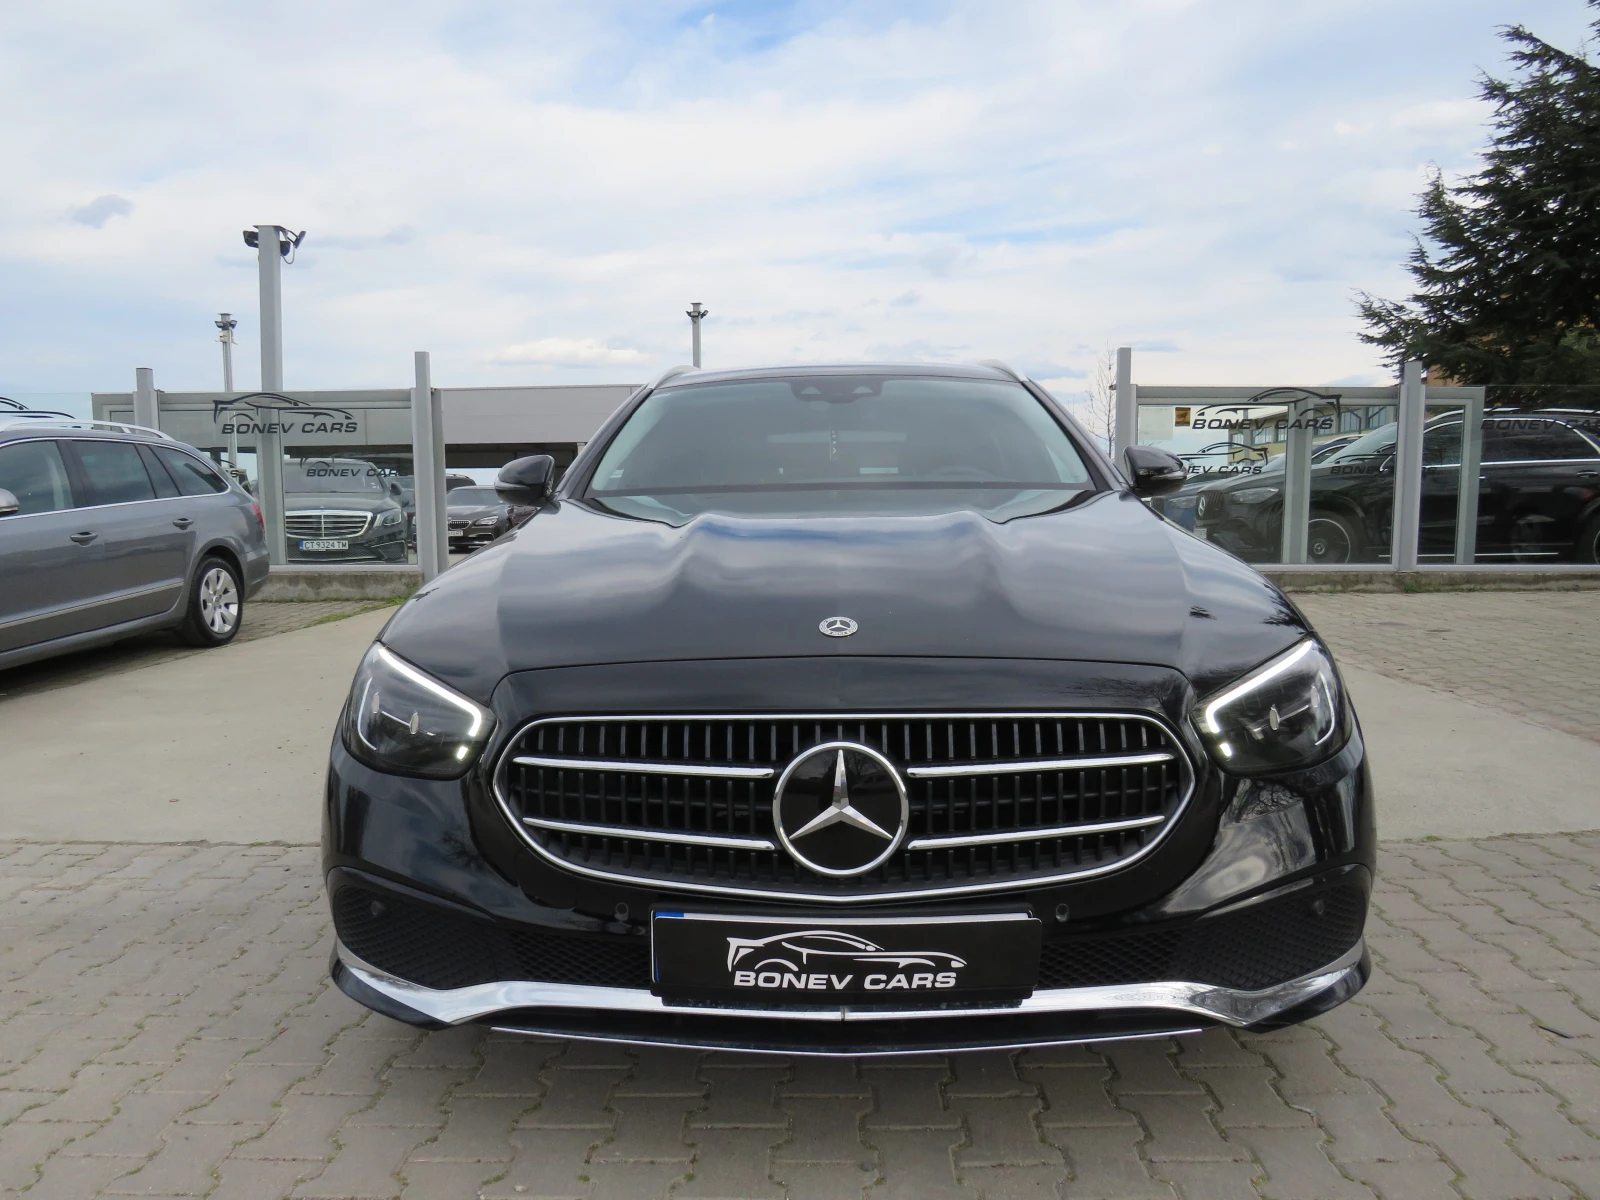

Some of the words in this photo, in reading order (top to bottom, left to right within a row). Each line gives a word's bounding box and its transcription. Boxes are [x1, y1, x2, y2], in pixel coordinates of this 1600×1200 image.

[221, 422, 295, 434] BONEV
[301, 422, 358, 434] CARS
[1192, 418, 1266, 430] BONEV
[1274, 418, 1334, 430] CARS
[306, 468, 361, 477] BONEV
[366, 468, 399, 477] CAR
[1218, 465, 1263, 475] CARS
[1330, 465, 1379, 474] BONE
[316, 541, 335, 549] 9324
[336, 541, 347, 549] TM
[733, 970, 853, 990] BONEV
[863, 971, 957, 990] CARS
